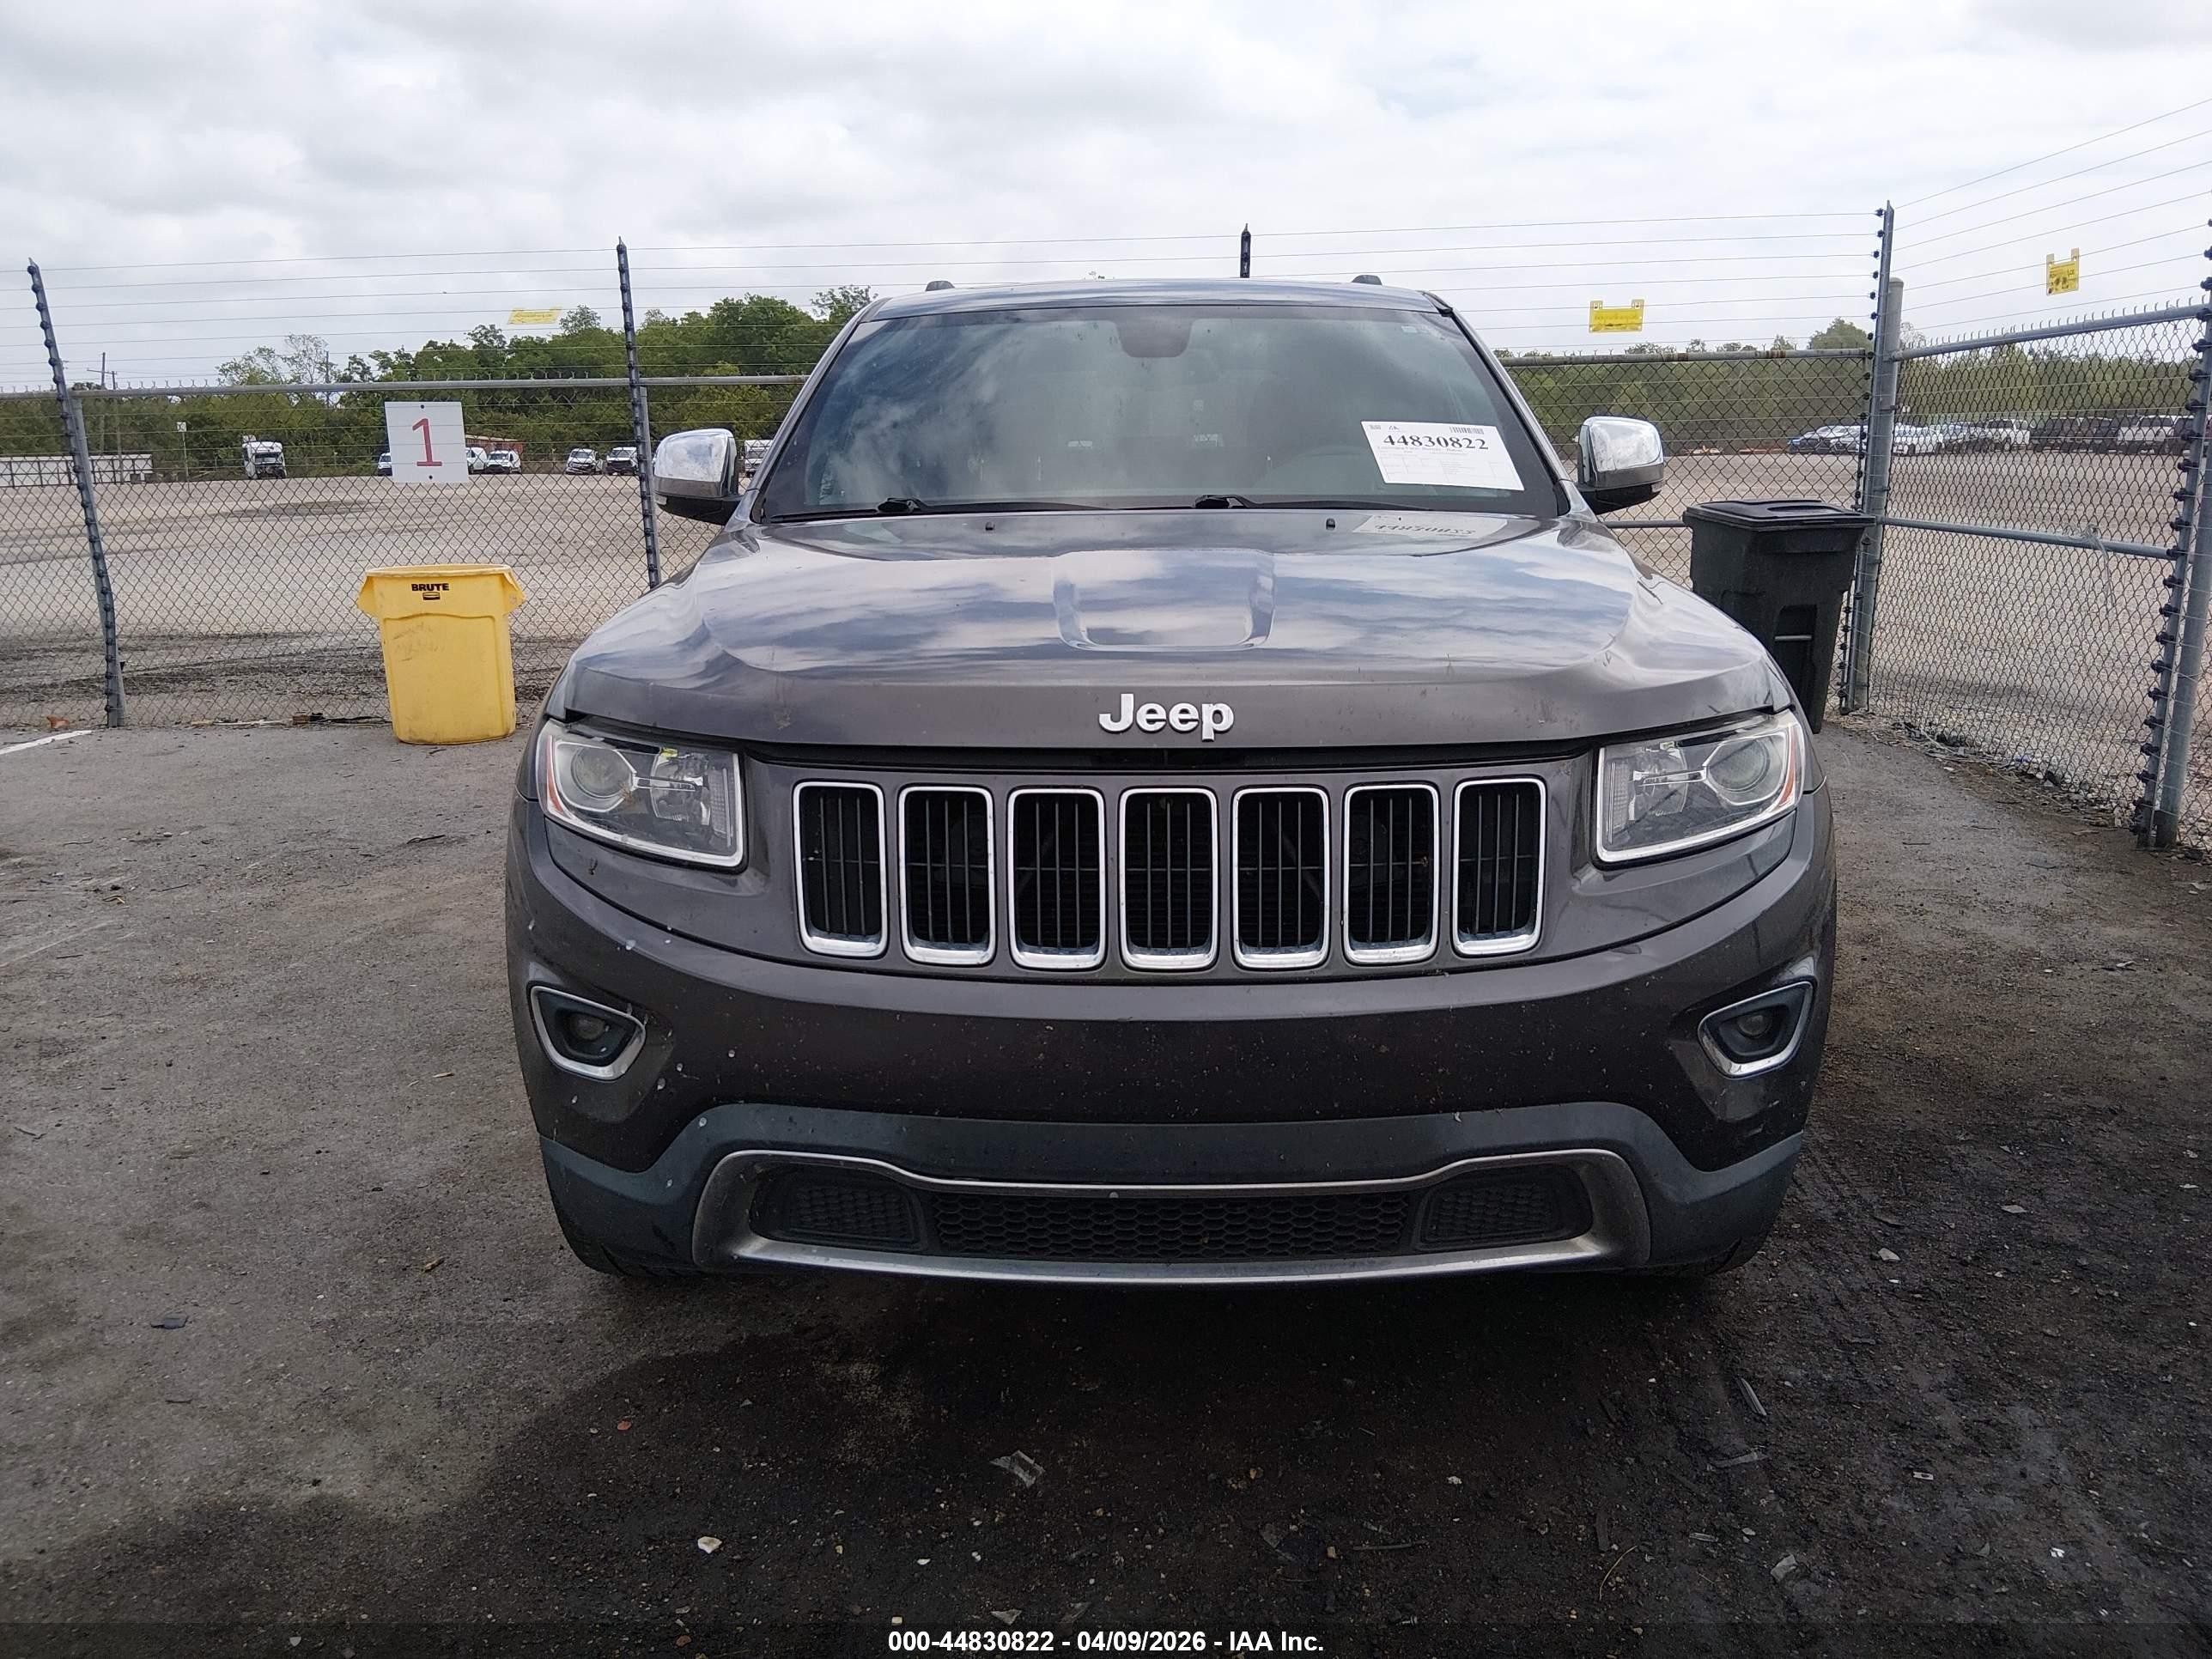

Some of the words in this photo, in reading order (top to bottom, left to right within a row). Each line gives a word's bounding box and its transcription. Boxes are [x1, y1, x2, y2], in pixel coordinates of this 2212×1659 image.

[412, 418, 442, 466] 1
[1383, 434, 1489, 450] 44830822
[411, 583, 449, 592] BRUTE
[1098, 692, 1235, 742] Jeep
